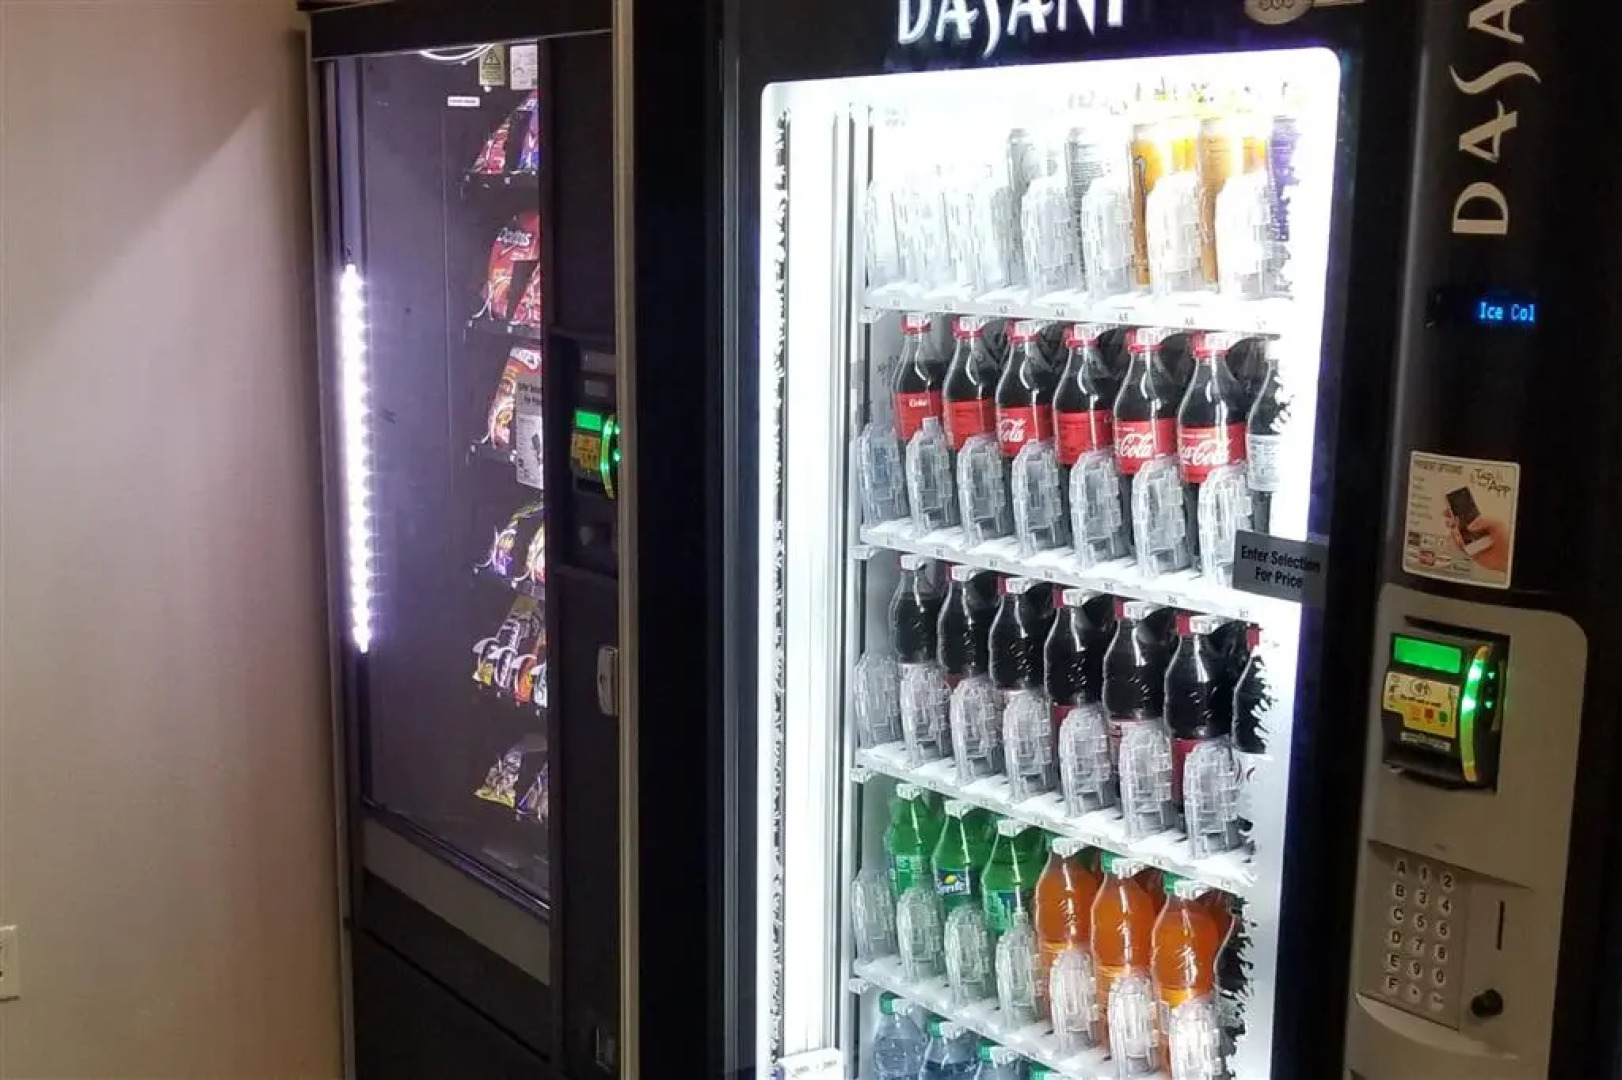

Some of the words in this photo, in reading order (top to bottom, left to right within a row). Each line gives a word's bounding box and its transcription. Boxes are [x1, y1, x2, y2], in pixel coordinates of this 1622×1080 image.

[1480, 302, 1504, 319] Ice
[1241, 545, 1269, 562] Enter
[1255, 566, 1273, 582] For
[1275, 570, 1304, 588] Price
[1397, 861, 1406, 875] A
[1443, 874, 1452, 888] 2
[1395, 884, 1405, 897] B
[1419, 891, 1427, 905] 3
[1442, 899, 1450, 913] 4
[1393, 907, 1404, 921] C
[1416, 938, 1423, 951] 7
[1390, 954, 1400, 967] E
[1389, 977, 1399, 989] F
